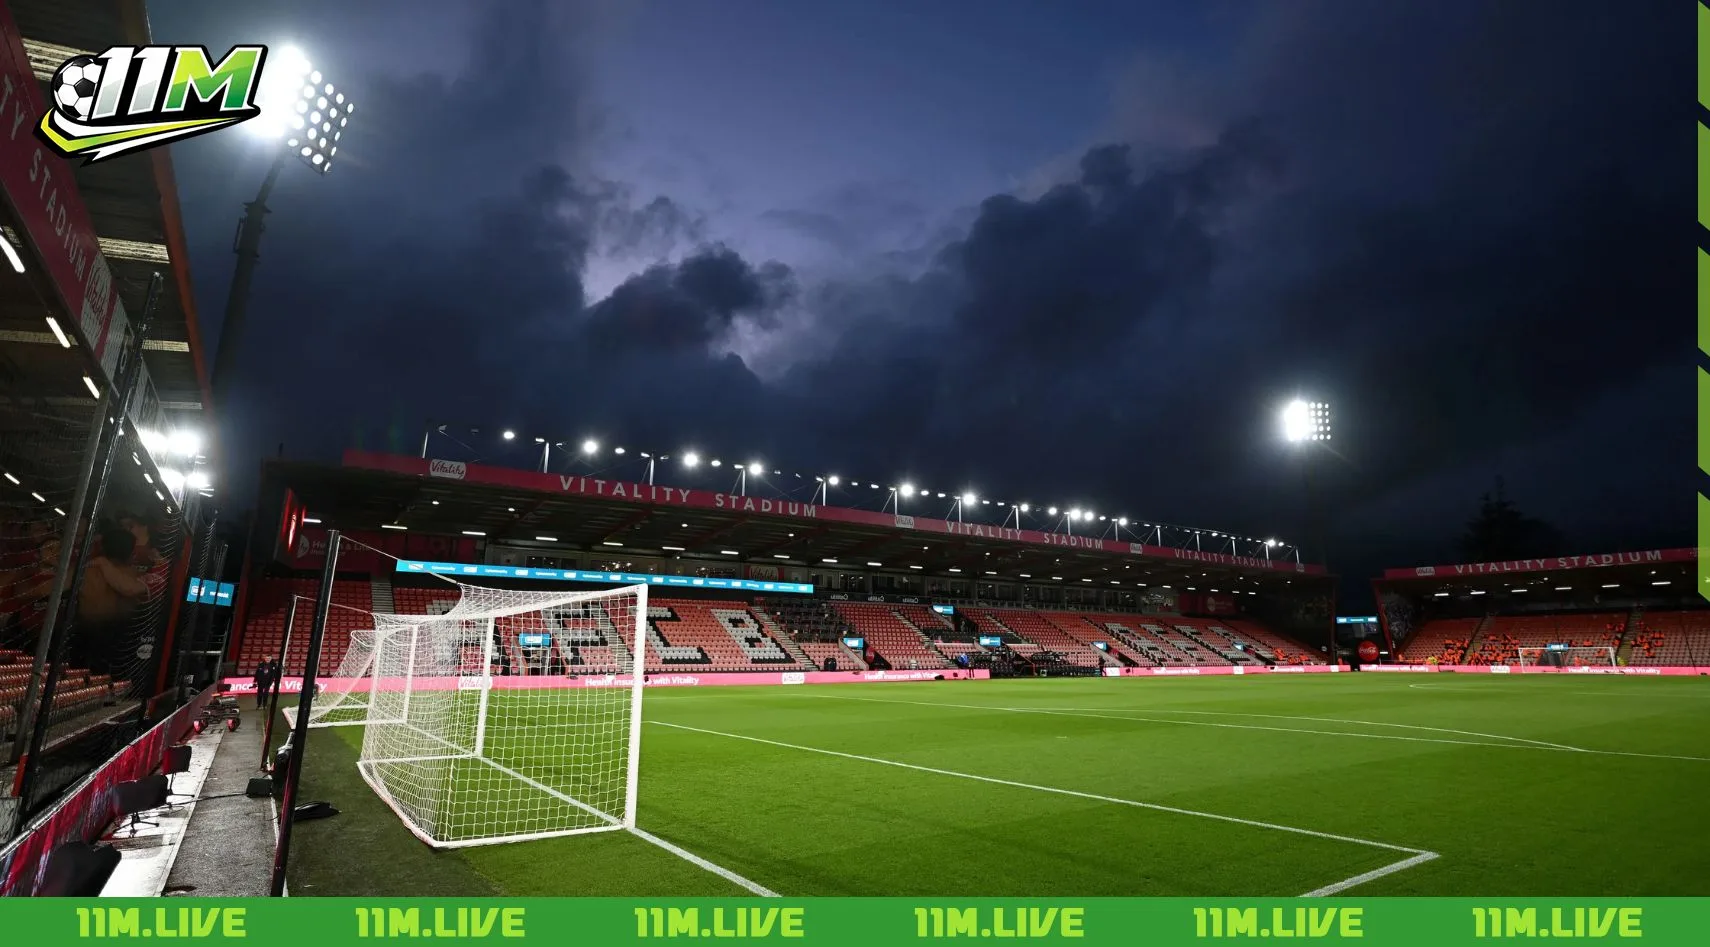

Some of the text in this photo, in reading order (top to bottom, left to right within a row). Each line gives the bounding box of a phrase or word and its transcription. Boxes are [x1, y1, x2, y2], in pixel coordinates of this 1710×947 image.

[29, 148, 86, 280] STADIUM
[560, 475, 816, 517] VITALITY STADIUM
[946, 521, 1103, 549] VITALITY STADIUM
[1174, 549, 1273, 568] VITALITY STADIUM
[1455, 558, 1546, 574] VITALITY
[1558, 550, 1663, 568] STADIUM
[653, 677, 670, 685] with
[671, 676, 699, 686] Vitality
